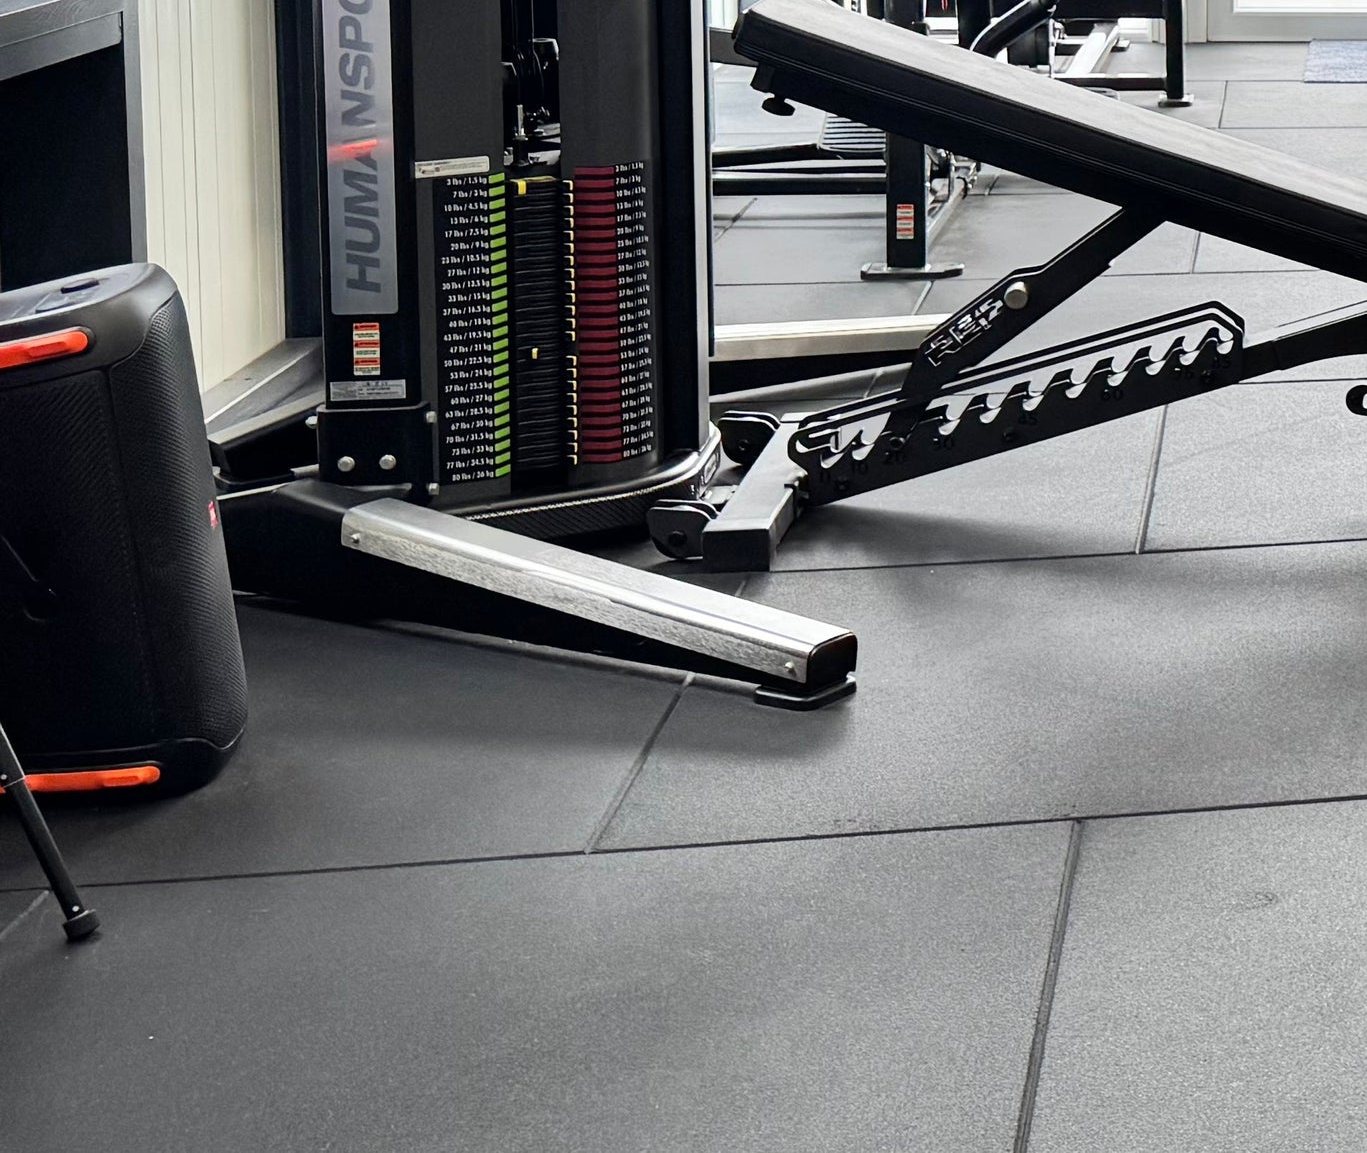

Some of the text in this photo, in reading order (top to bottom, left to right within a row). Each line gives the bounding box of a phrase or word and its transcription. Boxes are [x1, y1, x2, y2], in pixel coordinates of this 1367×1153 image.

[479, 176, 487, 184] kg
[480, 189, 487, 197] kg
[480, 202, 487, 210] kg
[480, 215, 488, 223] kg
[481, 228, 488, 236] kg
[481, 241, 489, 249] kg
[481, 254, 489, 262] kg
[482, 266, 489, 274] kg
[482, 279, 489, 287] kg
[482, 292, 490, 300] kg
[483, 304, 490, 313] kg
[483, 330, 491, 338] kg
[484, 343, 491, 351] kg
[484, 356, 492, 364] kg
[484, 369, 492, 377] kg
[485, 394, 492, 402] kg
[485, 419, 493, 427] kg
[485, 432, 493, 440] kg
[486, 444, 493, 453] kg
[486, 457, 493, 465] kg
[486, 470, 494, 478] kg
